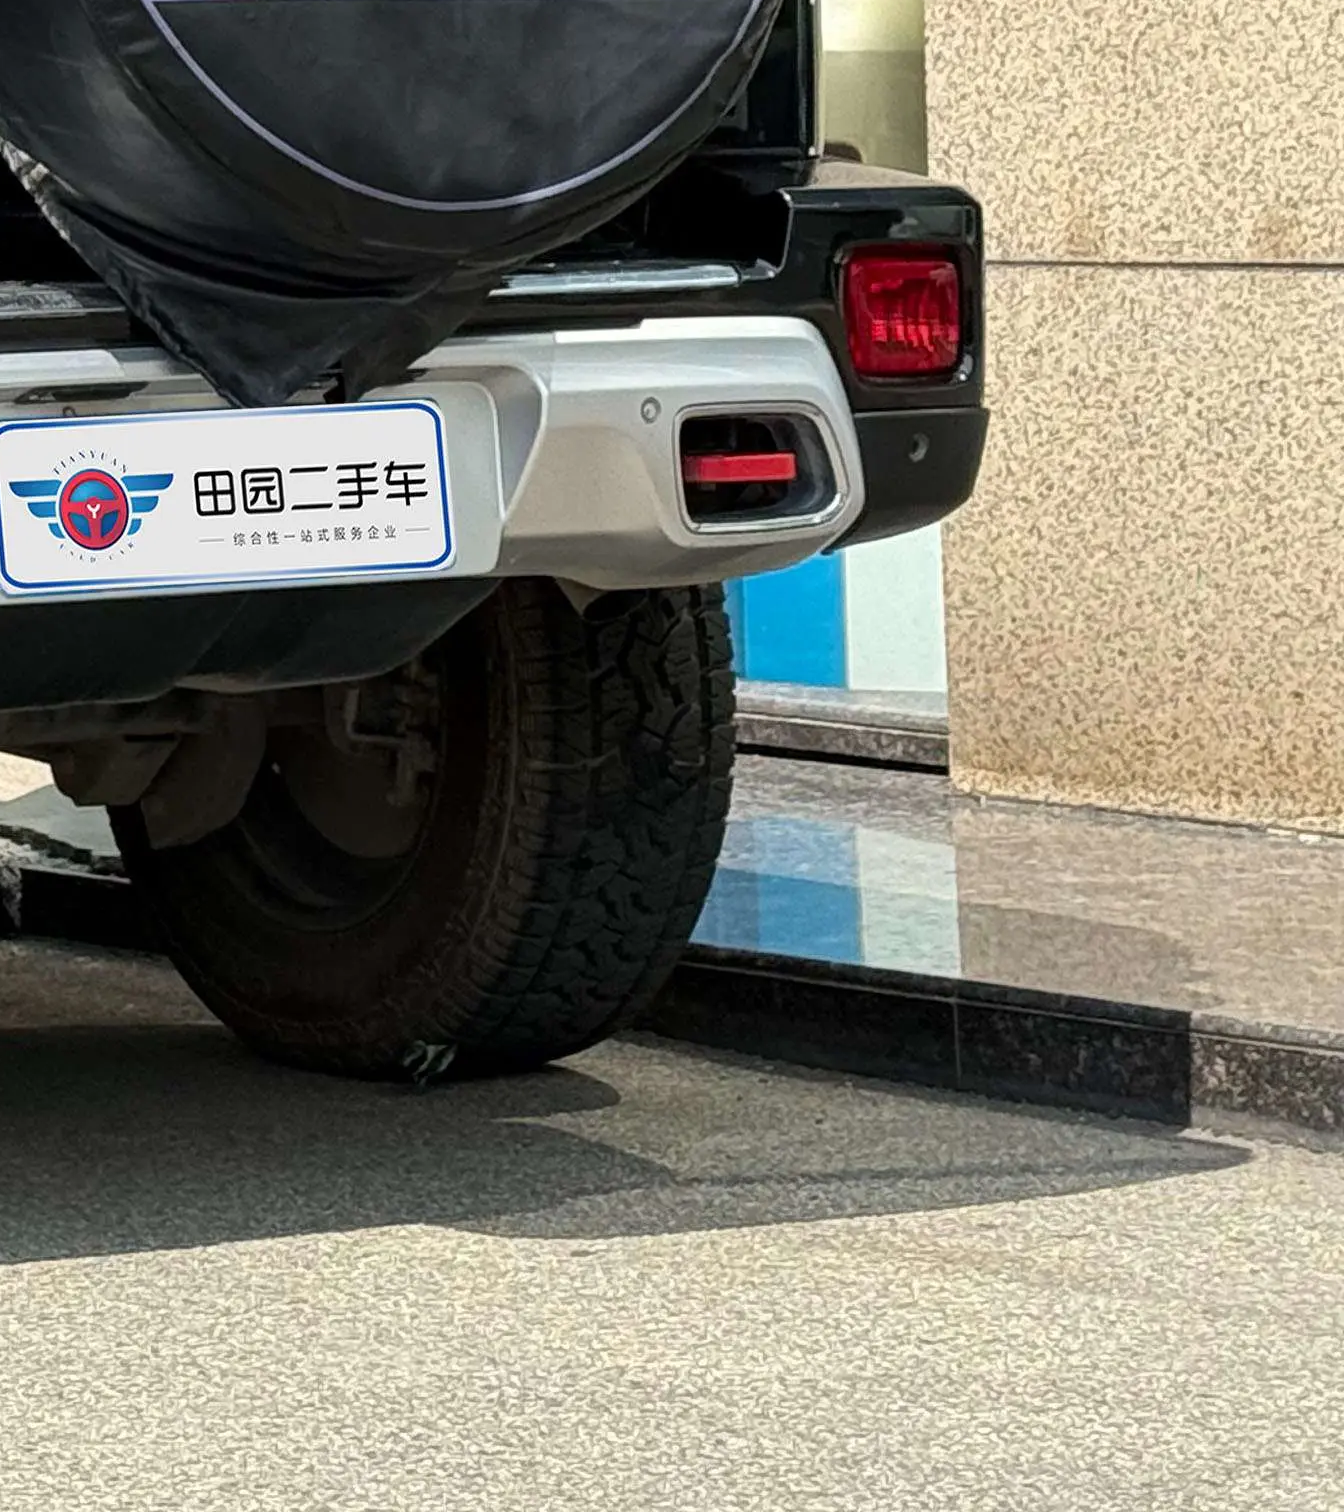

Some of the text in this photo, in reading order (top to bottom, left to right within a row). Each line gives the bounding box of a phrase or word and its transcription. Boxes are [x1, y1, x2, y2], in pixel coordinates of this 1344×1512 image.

[194, 460, 428, 516] 田园二手车
[233, 524, 398, 547] 综合性一站式服务企业
